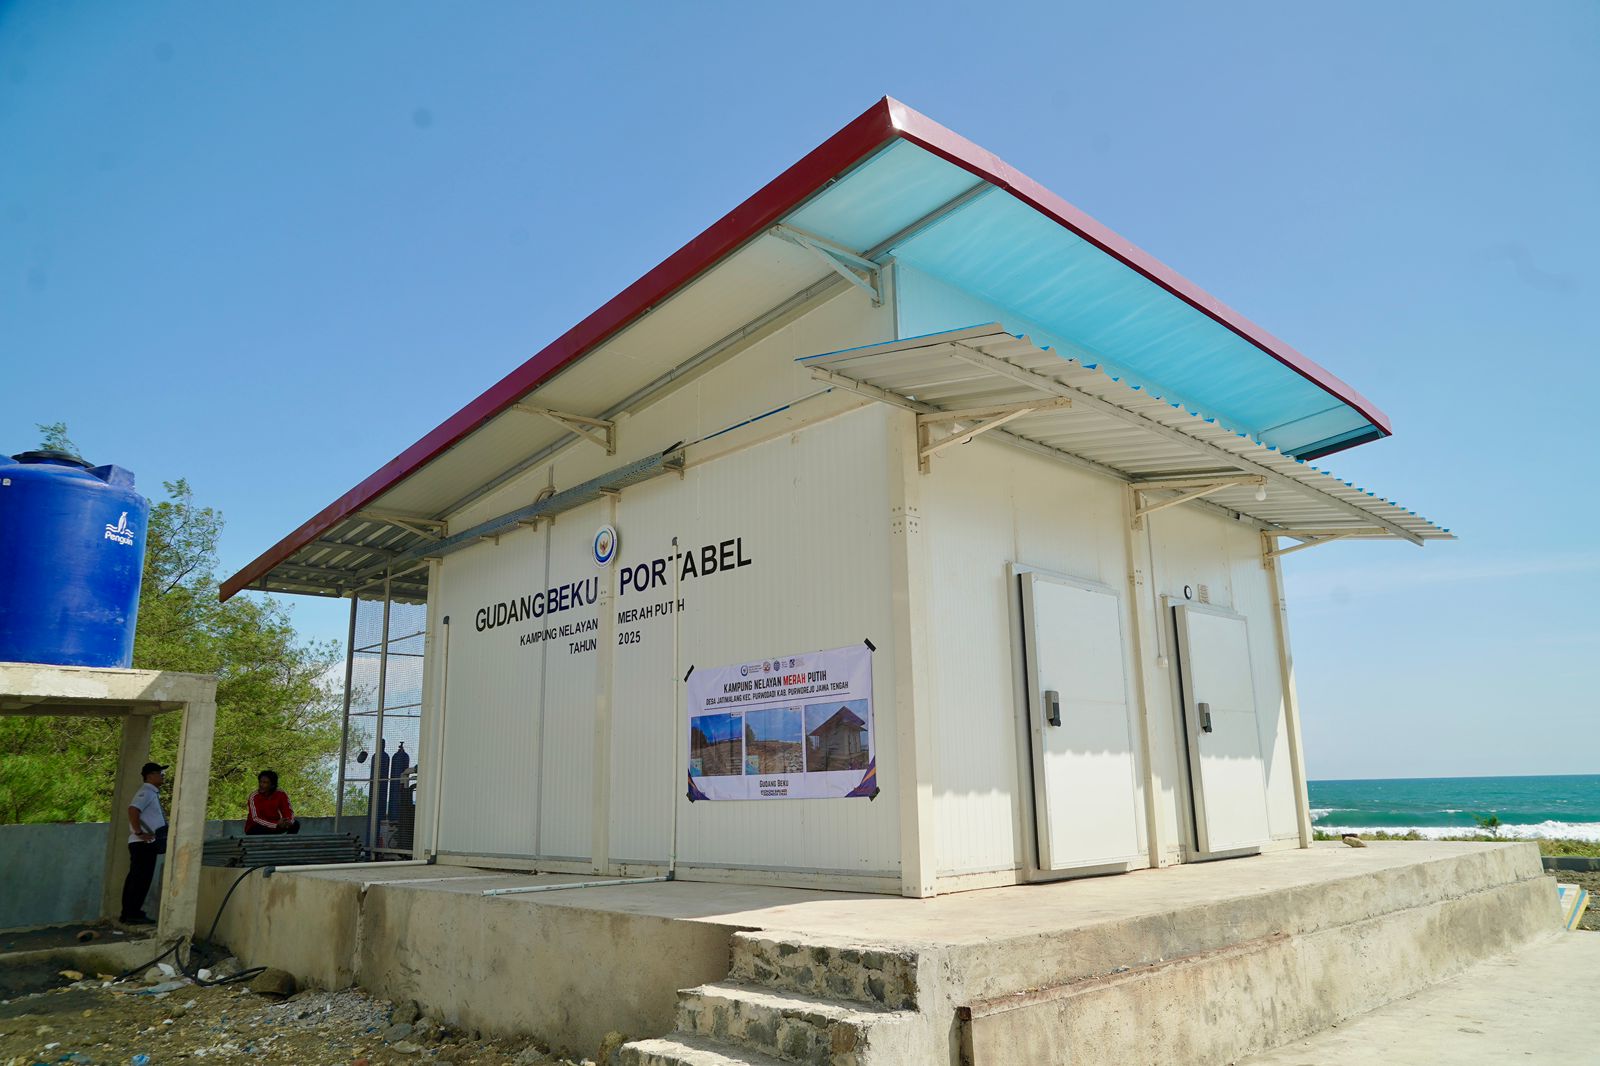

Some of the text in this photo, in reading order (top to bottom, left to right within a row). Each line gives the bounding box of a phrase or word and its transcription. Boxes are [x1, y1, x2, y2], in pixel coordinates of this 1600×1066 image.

[105, 531, 133, 546] Penguin
[520, 598, 685, 647] KAMPUNG NELAYAN MERAH PUTH
[568, 630, 641, 655] TAHUN 2025
[723, 670, 827, 694] KAMPUNG NELAYAN MERAH PUTIH
[815, 683, 829, 692] JAWA
[830, 681, 849, 691] TENGAH
